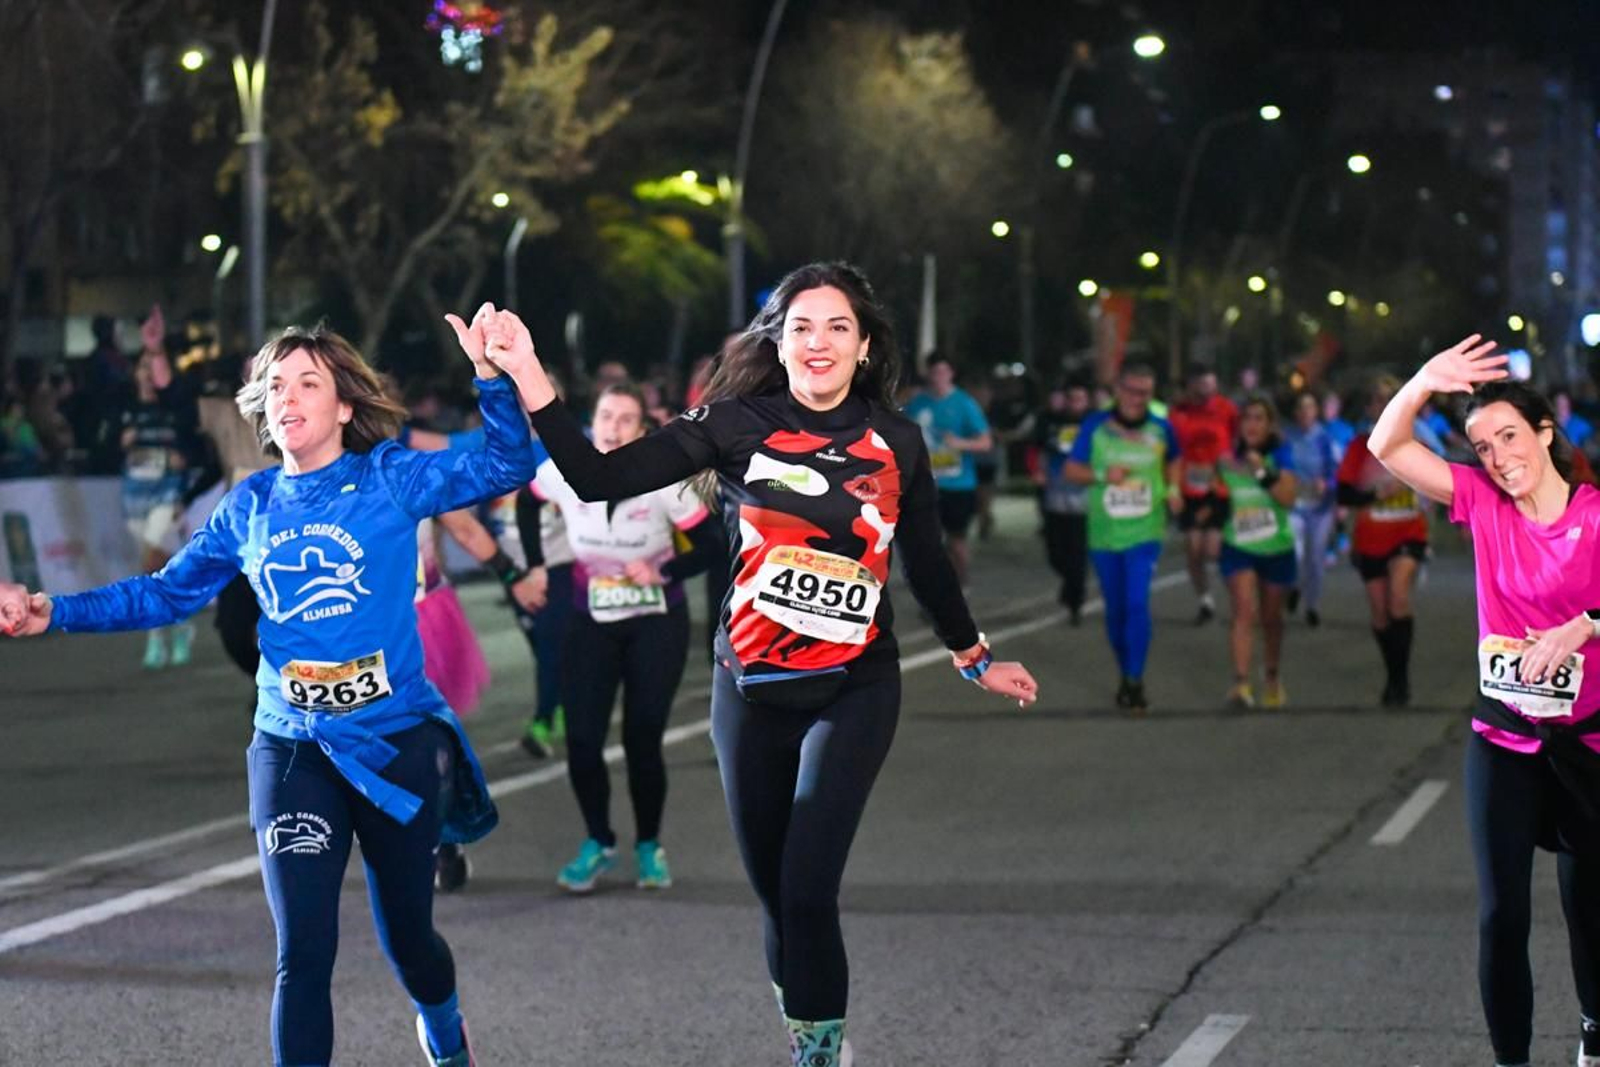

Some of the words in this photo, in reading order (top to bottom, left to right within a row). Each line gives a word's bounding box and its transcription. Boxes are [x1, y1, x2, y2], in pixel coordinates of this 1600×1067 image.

[270, 528, 299, 548] DEL
[770, 568, 868, 613] 4950
[302, 602, 353, 622] ALMANSA
[289, 671, 380, 706] 9263
